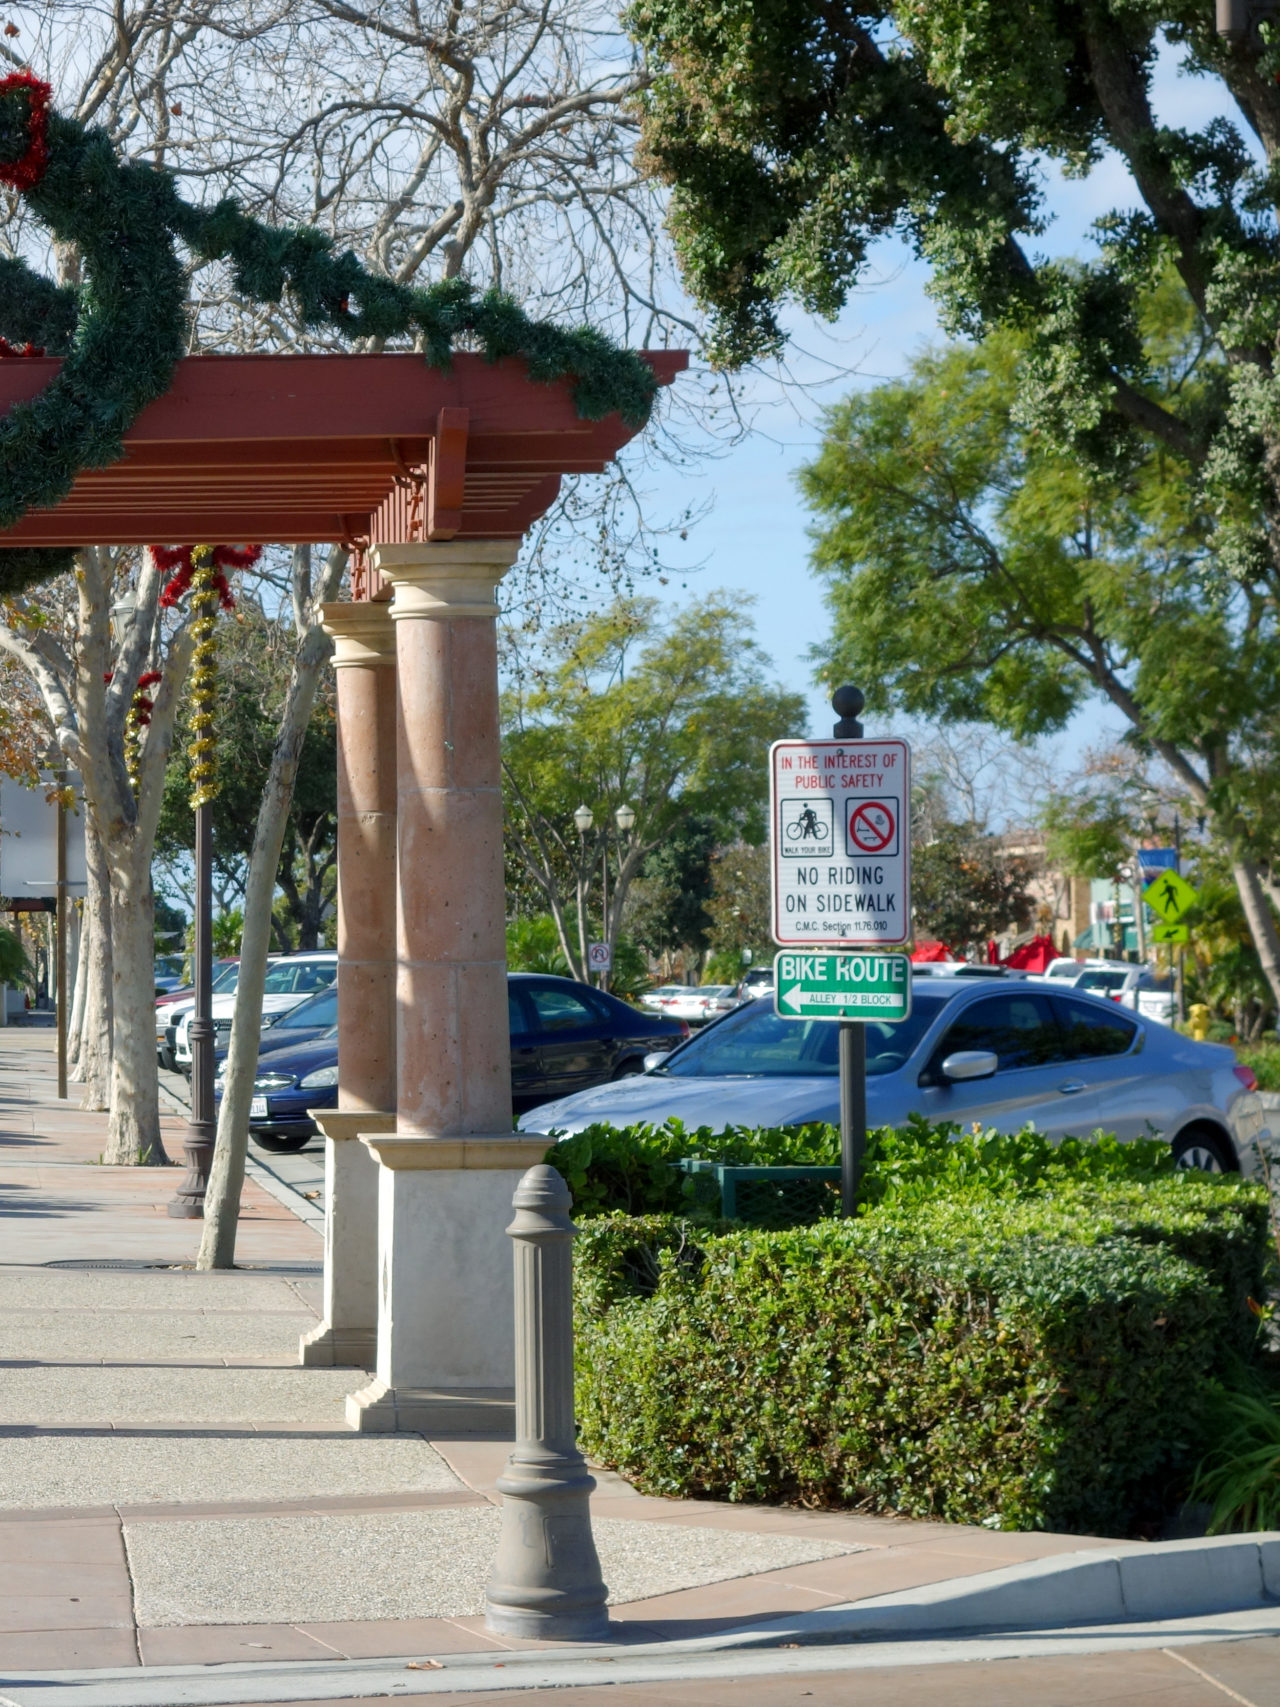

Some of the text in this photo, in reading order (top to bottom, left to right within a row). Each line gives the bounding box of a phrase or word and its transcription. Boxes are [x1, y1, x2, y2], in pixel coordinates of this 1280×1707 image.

[781, 753, 898, 769] IN THE INTEREST OF
[794, 773, 884, 789] PUBLIC SAFETY
[801, 846, 816, 854] YOUR
[818, 846, 831, 854] BIKE
[797, 866, 884, 885] NO RIDING
[785, 893, 896, 913] ON SIDEWALK
[795, 920, 888, 932] C.M.C. Section 11.76.010
[781, 956, 905, 982] BIKE ROUTE
[809, 993, 892, 1005] ALLEY 1/2 BLOCK
